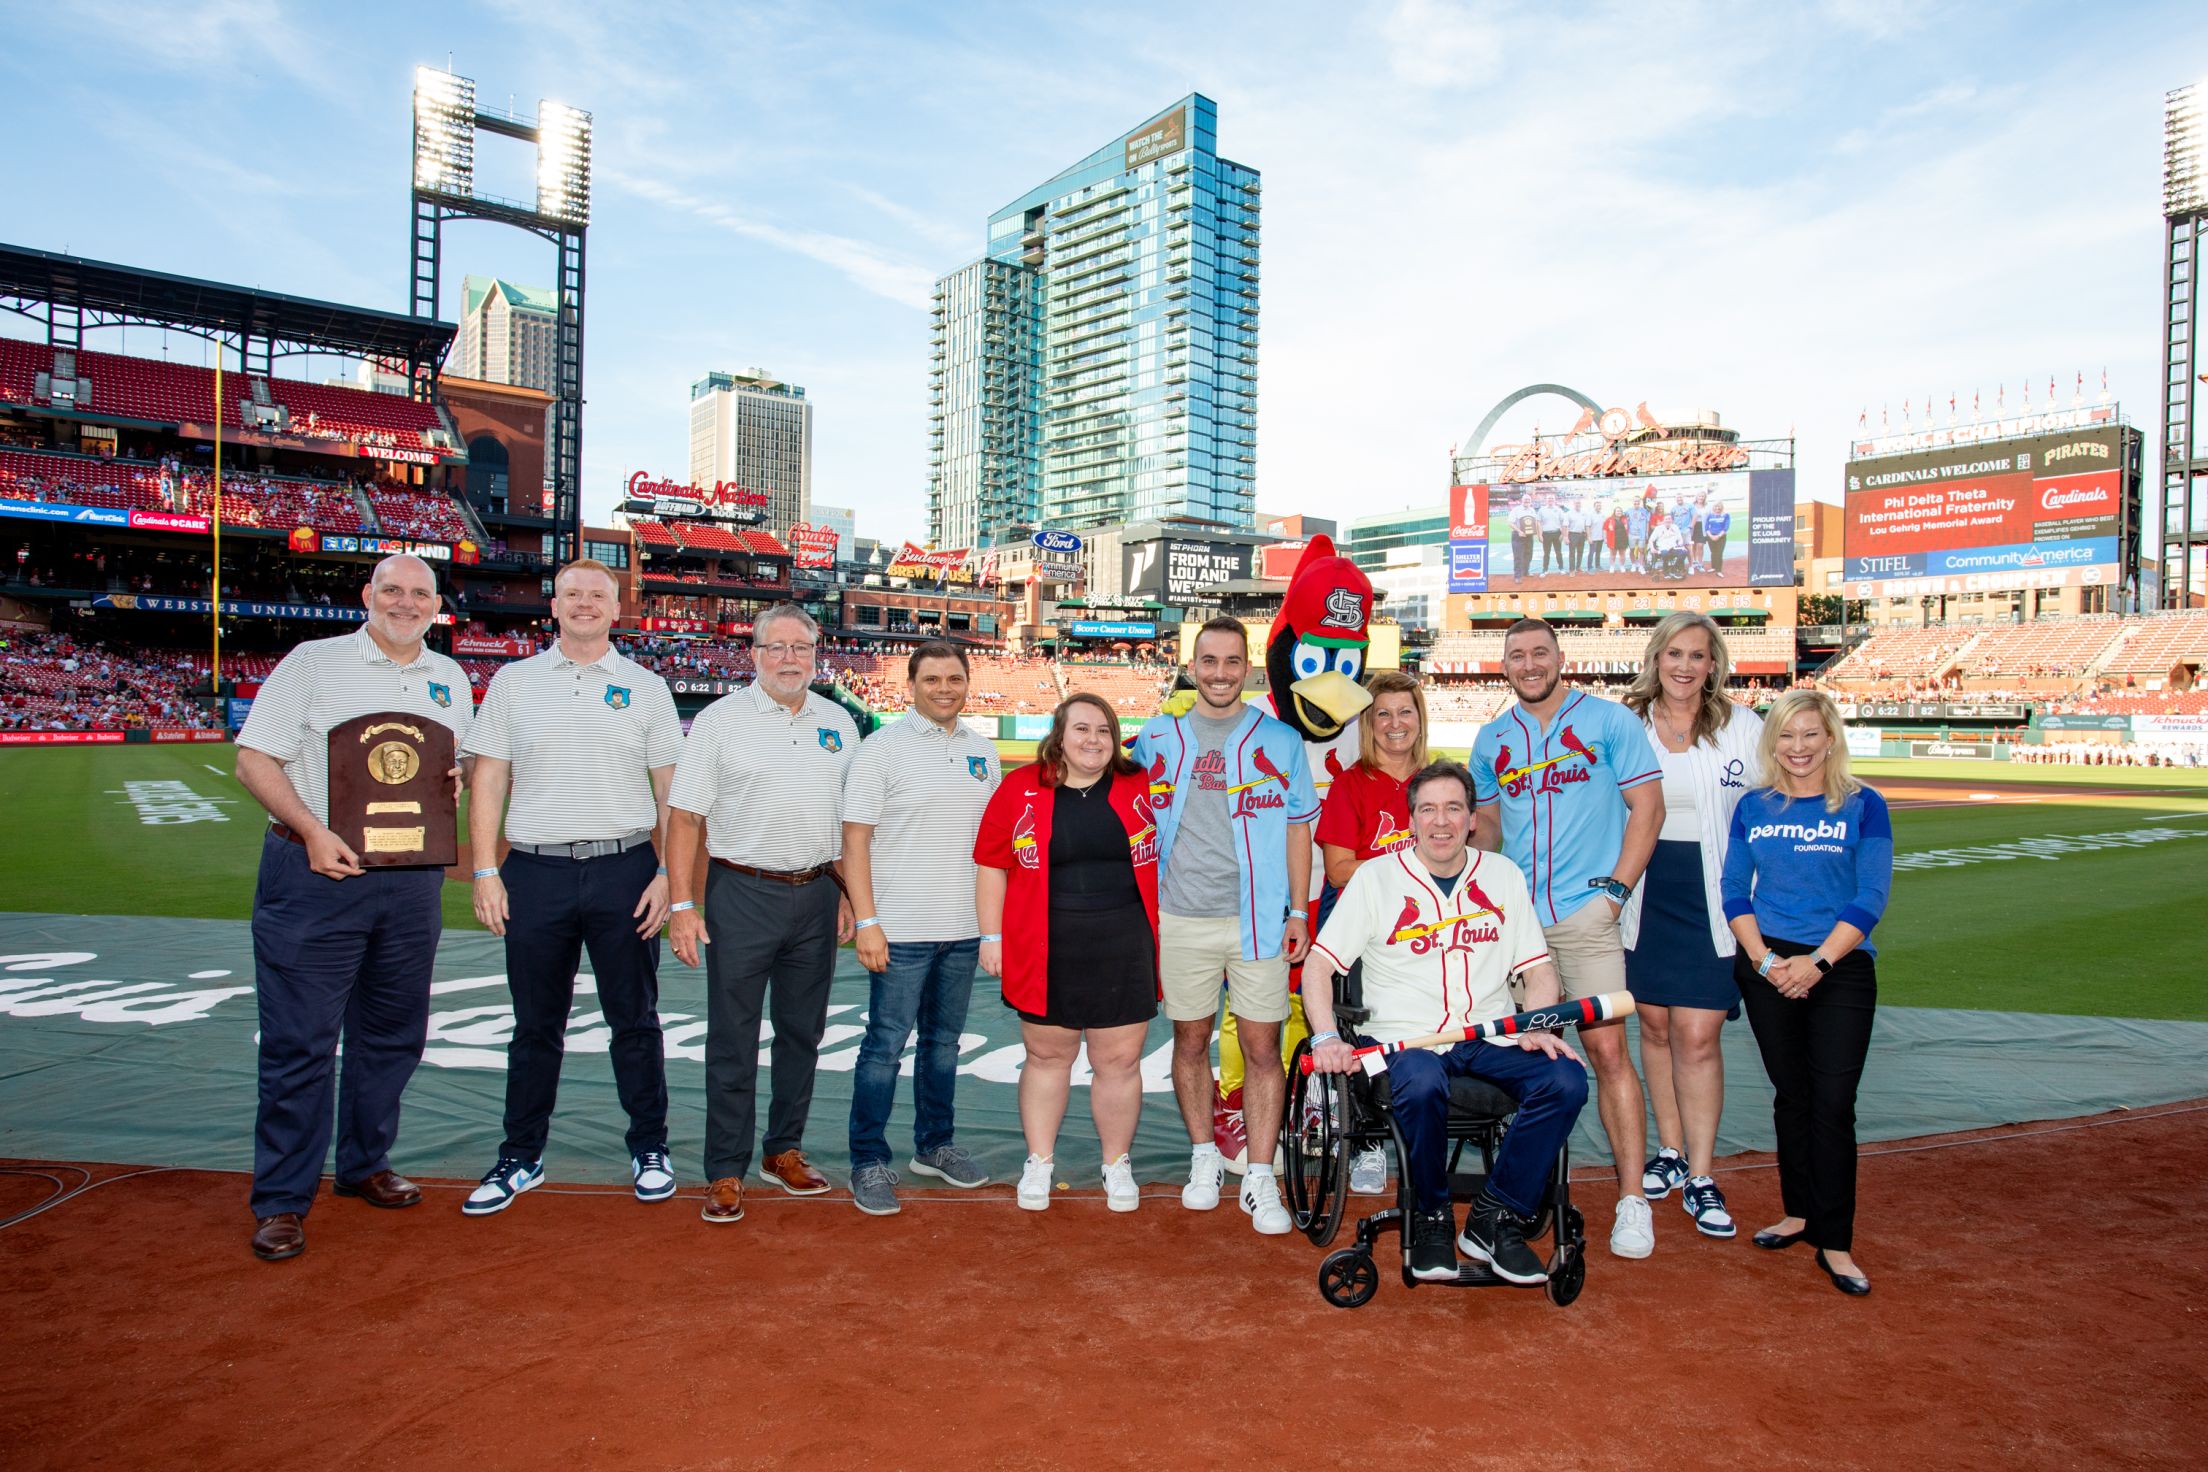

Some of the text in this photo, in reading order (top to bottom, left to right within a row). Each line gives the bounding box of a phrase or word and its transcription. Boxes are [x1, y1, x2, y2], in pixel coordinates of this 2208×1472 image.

[1129, 129, 1164, 152] WATCH THE
[367, 446, 435, 464] WELCOME
[1491, 442, 1749, 483] Budweiser
[2044, 442, 2109, 467] PIRATES
[1865, 466, 1938, 486] CARDINALS
[1939, 458, 2011, 477] WELCOME
[629, 471, 767, 507] Cardinals Nation
[1884, 488, 1987, 509] Phi Delta Theta
[2041, 487, 2109, 510] Cardinals
[711, 508, 755, 520] ROOFTOP
[1859, 498, 2015, 524] International Fraternity
[133, 513, 206, 530] Cardinals CARE
[1869, 514, 2003, 536] Lou Gehrig Memorial Award
[2034, 520, 2062, 528] BASEBALL
[2062, 518, 2084, 526] PLAYER
[788, 521, 840, 550] Bally
[2034, 527, 2069, 535] EXEMPLIFIES
[322, 536, 451, 560] BIG MAC LAND
[1043, 532, 1075, 549] Ford
[893, 547, 974, 567] Budweiser
[1169, 552, 1240, 570] FROM THE
[1859, 556, 1911, 574] STIFEL
[888, 565, 974, 583] BREW HUSE
[1168, 566, 1230, 583] LOU AND
[1882, 577, 1946, 596] BROWN
[1965, 570, 2068, 591] CROUPPEN
[1168, 579, 1214, 594] WE'R
[146, 598, 368, 619] WEBSTER UNIVERSITY
[1634, 597, 1650, 610] 23
[1683, 595, 1701, 609] 42
[1709, 595, 1728, 609] 45
[1074, 624, 1153, 634] SCOTT CREDIT UNION
[456, 638, 510, 648] Schnucks
[1577, 661, 1629, 674] LOUIS
[690, 683, 709, 692] 6:22
[1878, 706, 1899, 715] 6:22
[2, 733, 121, 742] Budweiser Budweiser Budweiser
[1927, 744, 1955, 757] Bally
[1506, 762, 1590, 798] St. Louis
[1720, 759, 1745, 788] Lou
[1229, 785, 1282, 817] Louis
[1748, 819, 1847, 843] permobil
[1793, 844, 1843, 853] FOUNDATION
[1410, 918, 1499, 955] St. Louis
